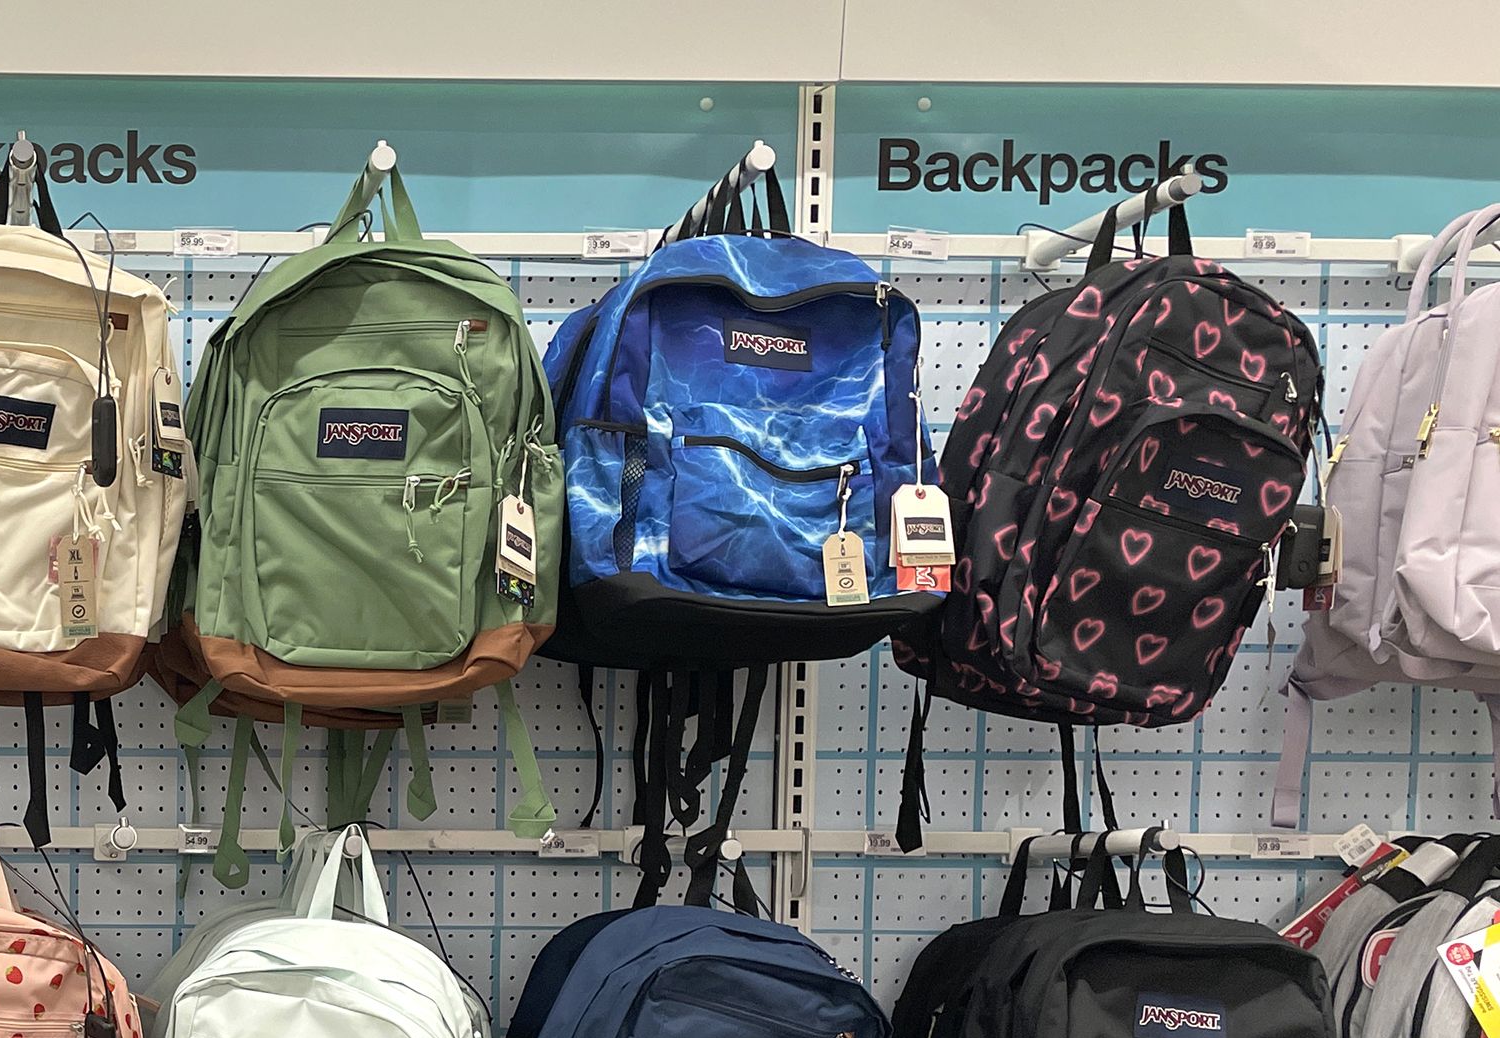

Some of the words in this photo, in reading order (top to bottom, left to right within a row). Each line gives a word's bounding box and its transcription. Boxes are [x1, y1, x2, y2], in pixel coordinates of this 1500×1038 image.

[877, 137, 1229, 205] Backpacks
[180, 237, 205, 247] 59.99
[1252, 240, 1276, 250] 49.99
[730, 329, 808, 356] JANSPORT
[323, 422, 403, 445] JANSPORT
[1165, 469, 1242, 504] JANSPORT
[1257, 842, 1280, 852] 59.99
[1139, 1004, 1221, 1030] JANSPORT
